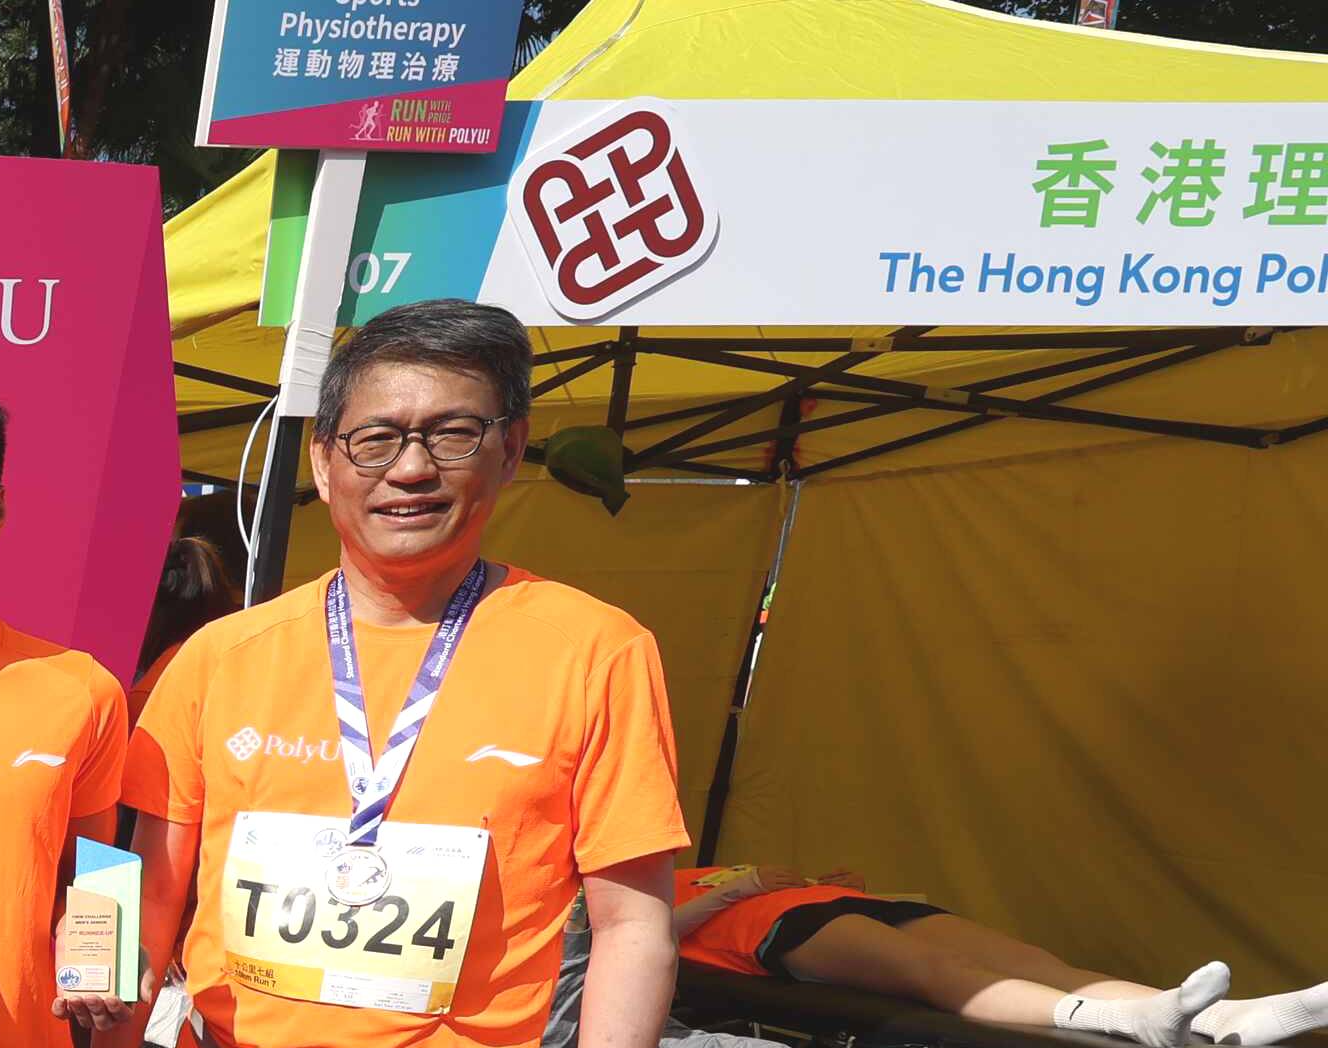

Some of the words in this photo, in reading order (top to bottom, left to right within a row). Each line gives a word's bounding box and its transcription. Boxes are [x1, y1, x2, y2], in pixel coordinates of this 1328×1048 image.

[279, 12, 466, 48] Physiotherapy
[272, 47, 461, 82] 運動物理治療
[390, 99, 428, 122] RUN
[429, 101, 452, 111] WITH
[386, 125, 412, 142] RUN
[414, 127, 446, 144] WITH
[448, 127, 491, 145] POLYU!
[1031, 138, 1328, 229] 香港理
[348, 251, 413, 294] 07
[878, 252, 965, 293] The
[977, 252, 1105, 307] Hong
[1118, 252, 1243, 307] Kong
[263, 734, 341, 765] PolyU
[235, 878, 456, 961] T0324
[252, 975, 270, 986] Run
